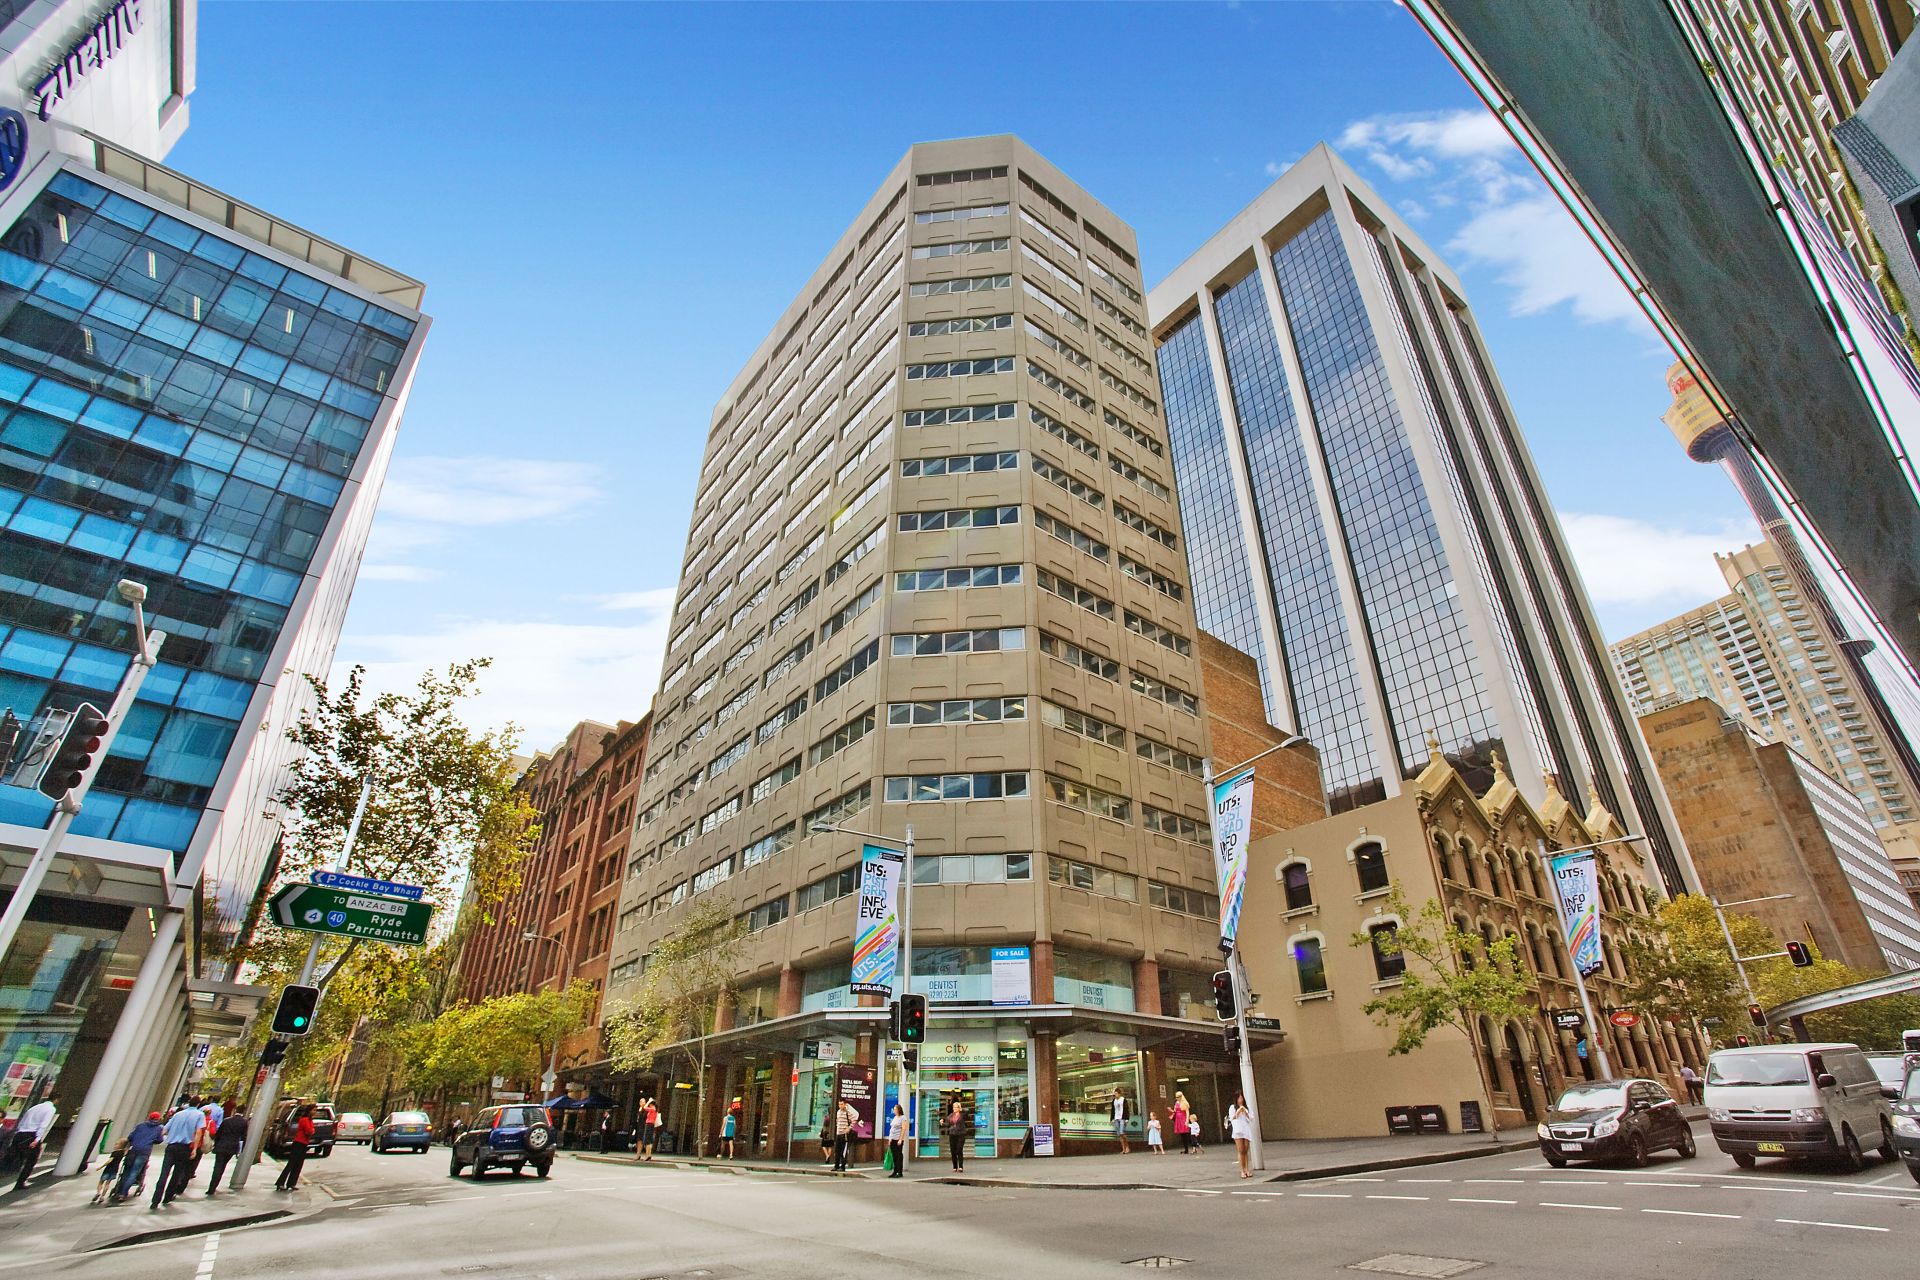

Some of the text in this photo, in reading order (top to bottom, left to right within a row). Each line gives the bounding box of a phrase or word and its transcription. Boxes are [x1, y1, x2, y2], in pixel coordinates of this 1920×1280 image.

[1218, 794, 1241, 816] UTS:
[865, 861, 887, 878] UTS:
[1557, 867, 1584, 880] UTS:
[338, 877, 369, 888] Cockle
[372, 882, 390, 893] Bay
[393, 886, 420, 896] Wharf
[1561, 884, 1590, 898] GRAD
[332, 895, 404, 914] TO ANZAC BR
[308, 911, 318, 921] 4
[329, 913, 344, 923] 40
[860, 906, 884, 919] EVE
[370, 914, 403, 928] Ryde
[347, 922, 419, 940] Parramatta
[1010, 949, 1025, 957] SALE
[852, 956, 879, 979] UTS:
[928, 980, 959, 990] DENTIST
[1082, 985, 1104, 997] DENTIST
[1251, 1017, 1269, 1026] Market
[822, 1047, 835, 1057] city
[945, 1044, 969, 1056] city
[921, 1055, 970, 1063] convenience
[1072, 1117, 1086, 1127] city
